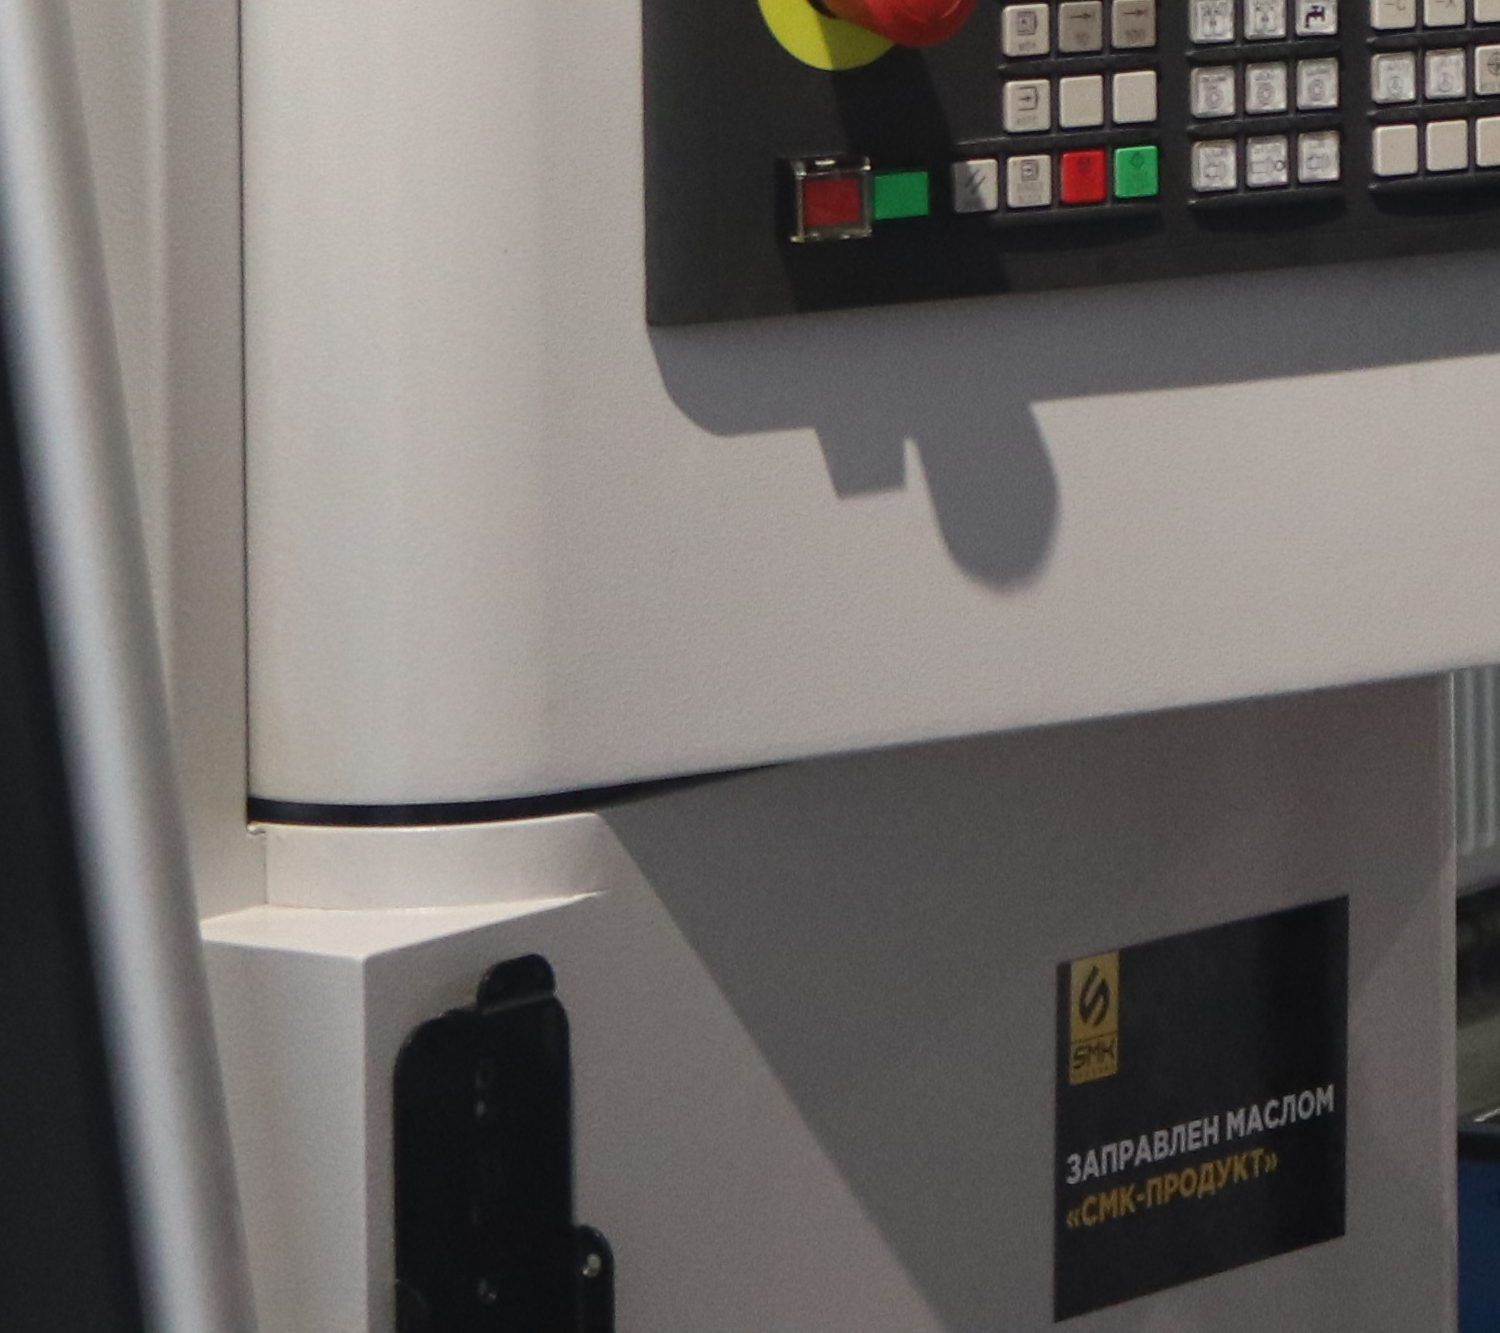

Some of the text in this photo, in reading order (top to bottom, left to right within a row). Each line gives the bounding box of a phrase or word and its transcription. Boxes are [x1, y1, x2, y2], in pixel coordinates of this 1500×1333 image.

[1072, 1037, 1116, 1070] SMK
[1066, 1085, 1336, 1185] ЗАПРАВЛЕН МАСЛОМ
[1066, 1147, 1279, 1229] «СМК-ПРОДУКТ»
